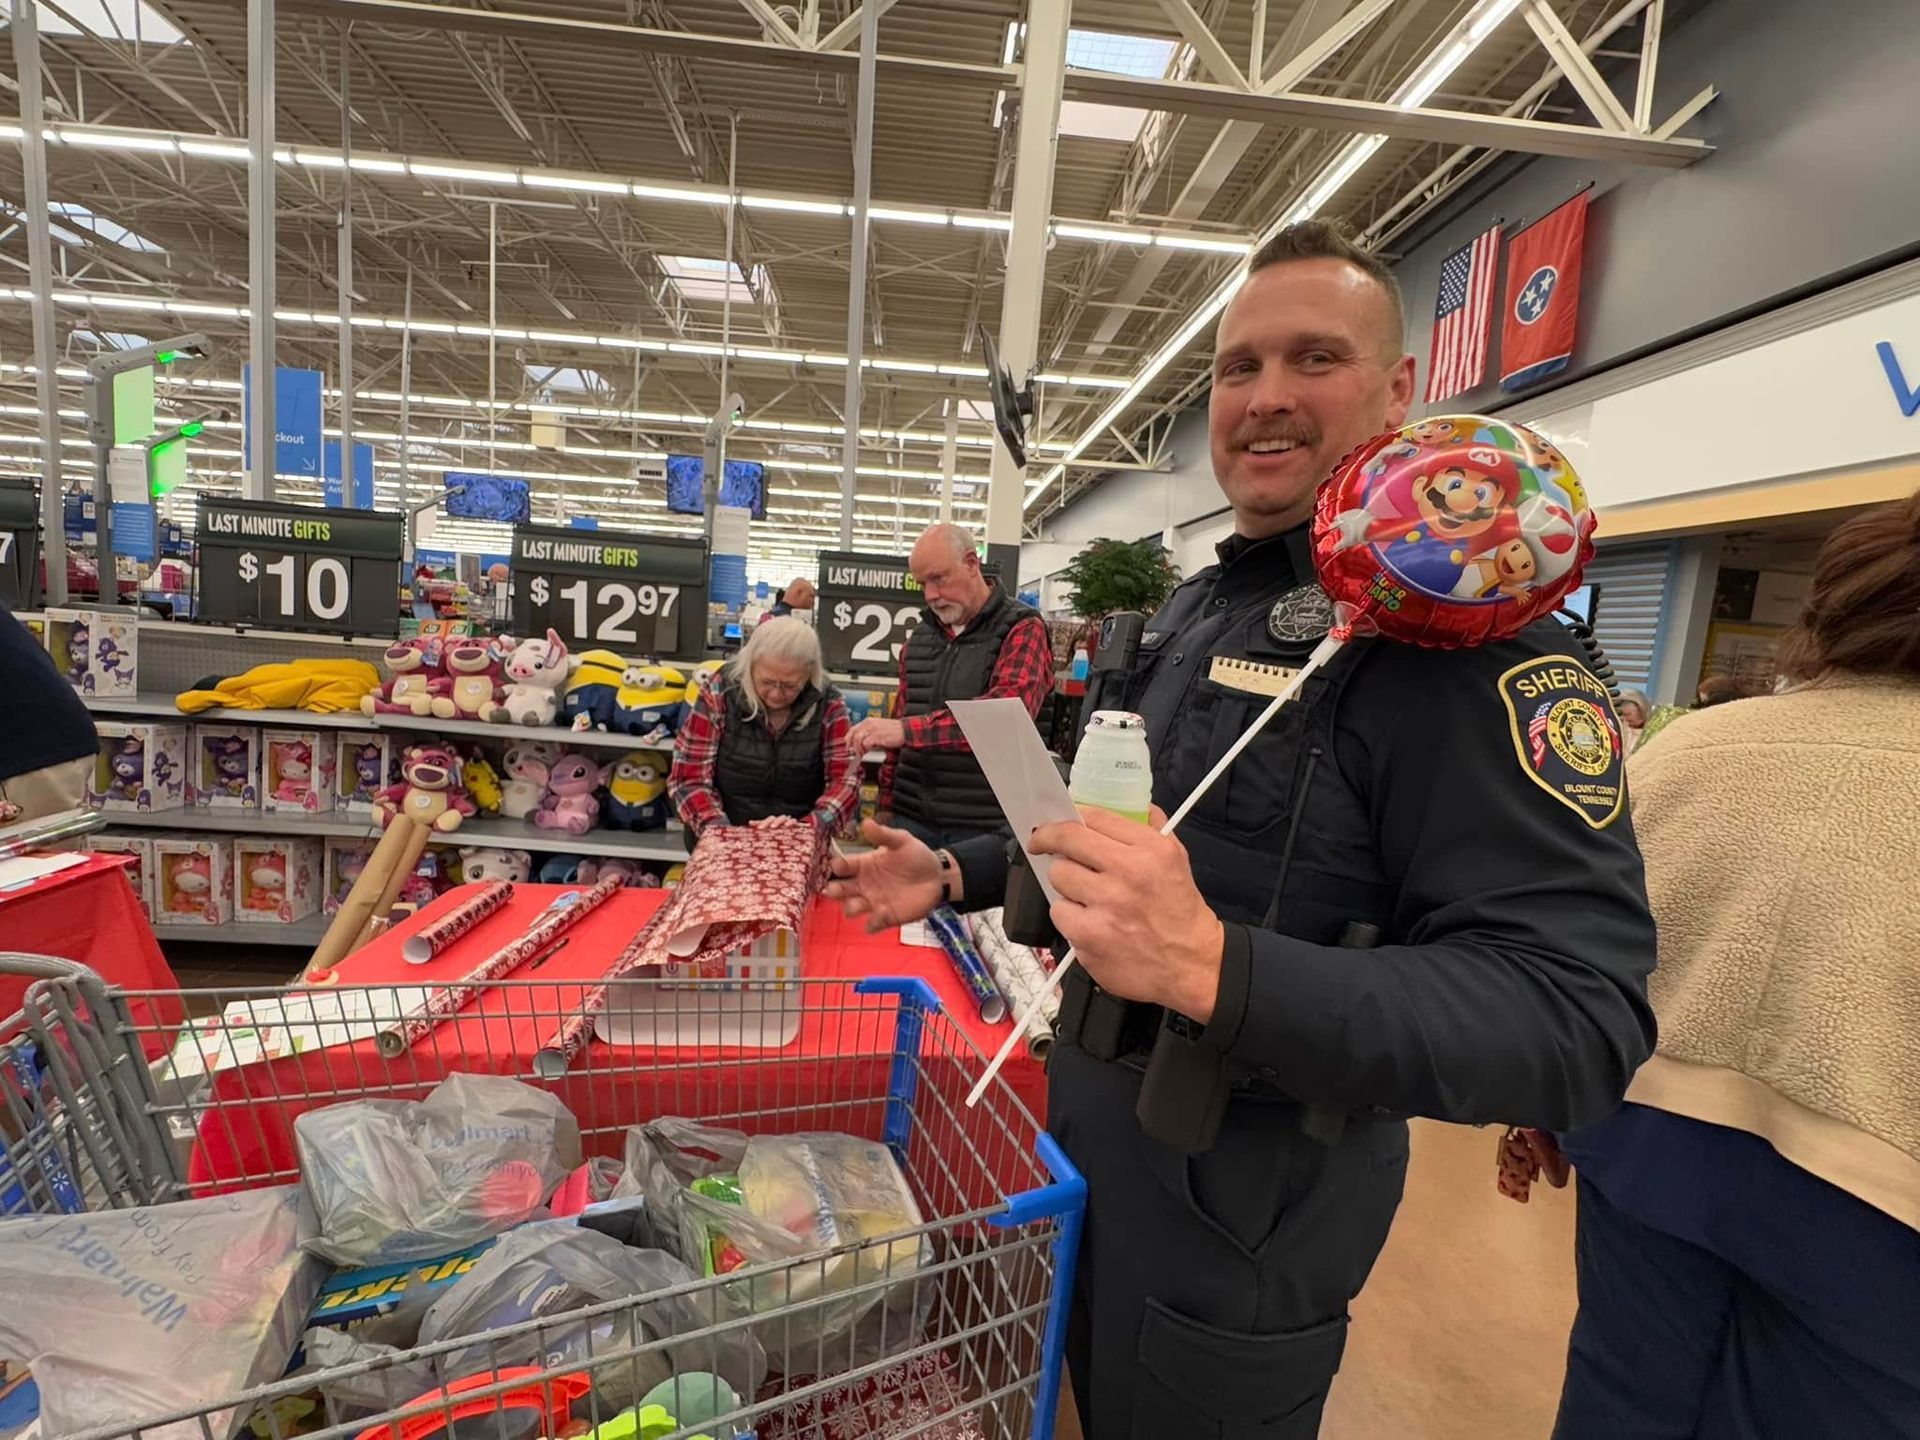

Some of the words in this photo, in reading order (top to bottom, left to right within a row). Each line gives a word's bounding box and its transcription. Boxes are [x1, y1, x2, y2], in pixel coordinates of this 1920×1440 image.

[275, 432, 305, 444] ckout
[208, 513, 239, 534] LAST
[241, 515, 292, 538] MINUTE
[293, 520, 331, 541] GIFTS
[522, 540, 552, 559] LAST
[553, 542, 602, 564] MINUTE
[603, 547, 638, 567] GIFTS
[828, 566, 857, 586] LAST
[857, 569, 904, 590] MINUTE
[1516, 669, 1604, 699] SHERIFF
[1564, 784, 1596, 794] BLOUNT
[130, 1209, 173, 1257] from
[57, 1224, 188, 1332] Walmart
[167, 1252, 206, 1284] Pay
